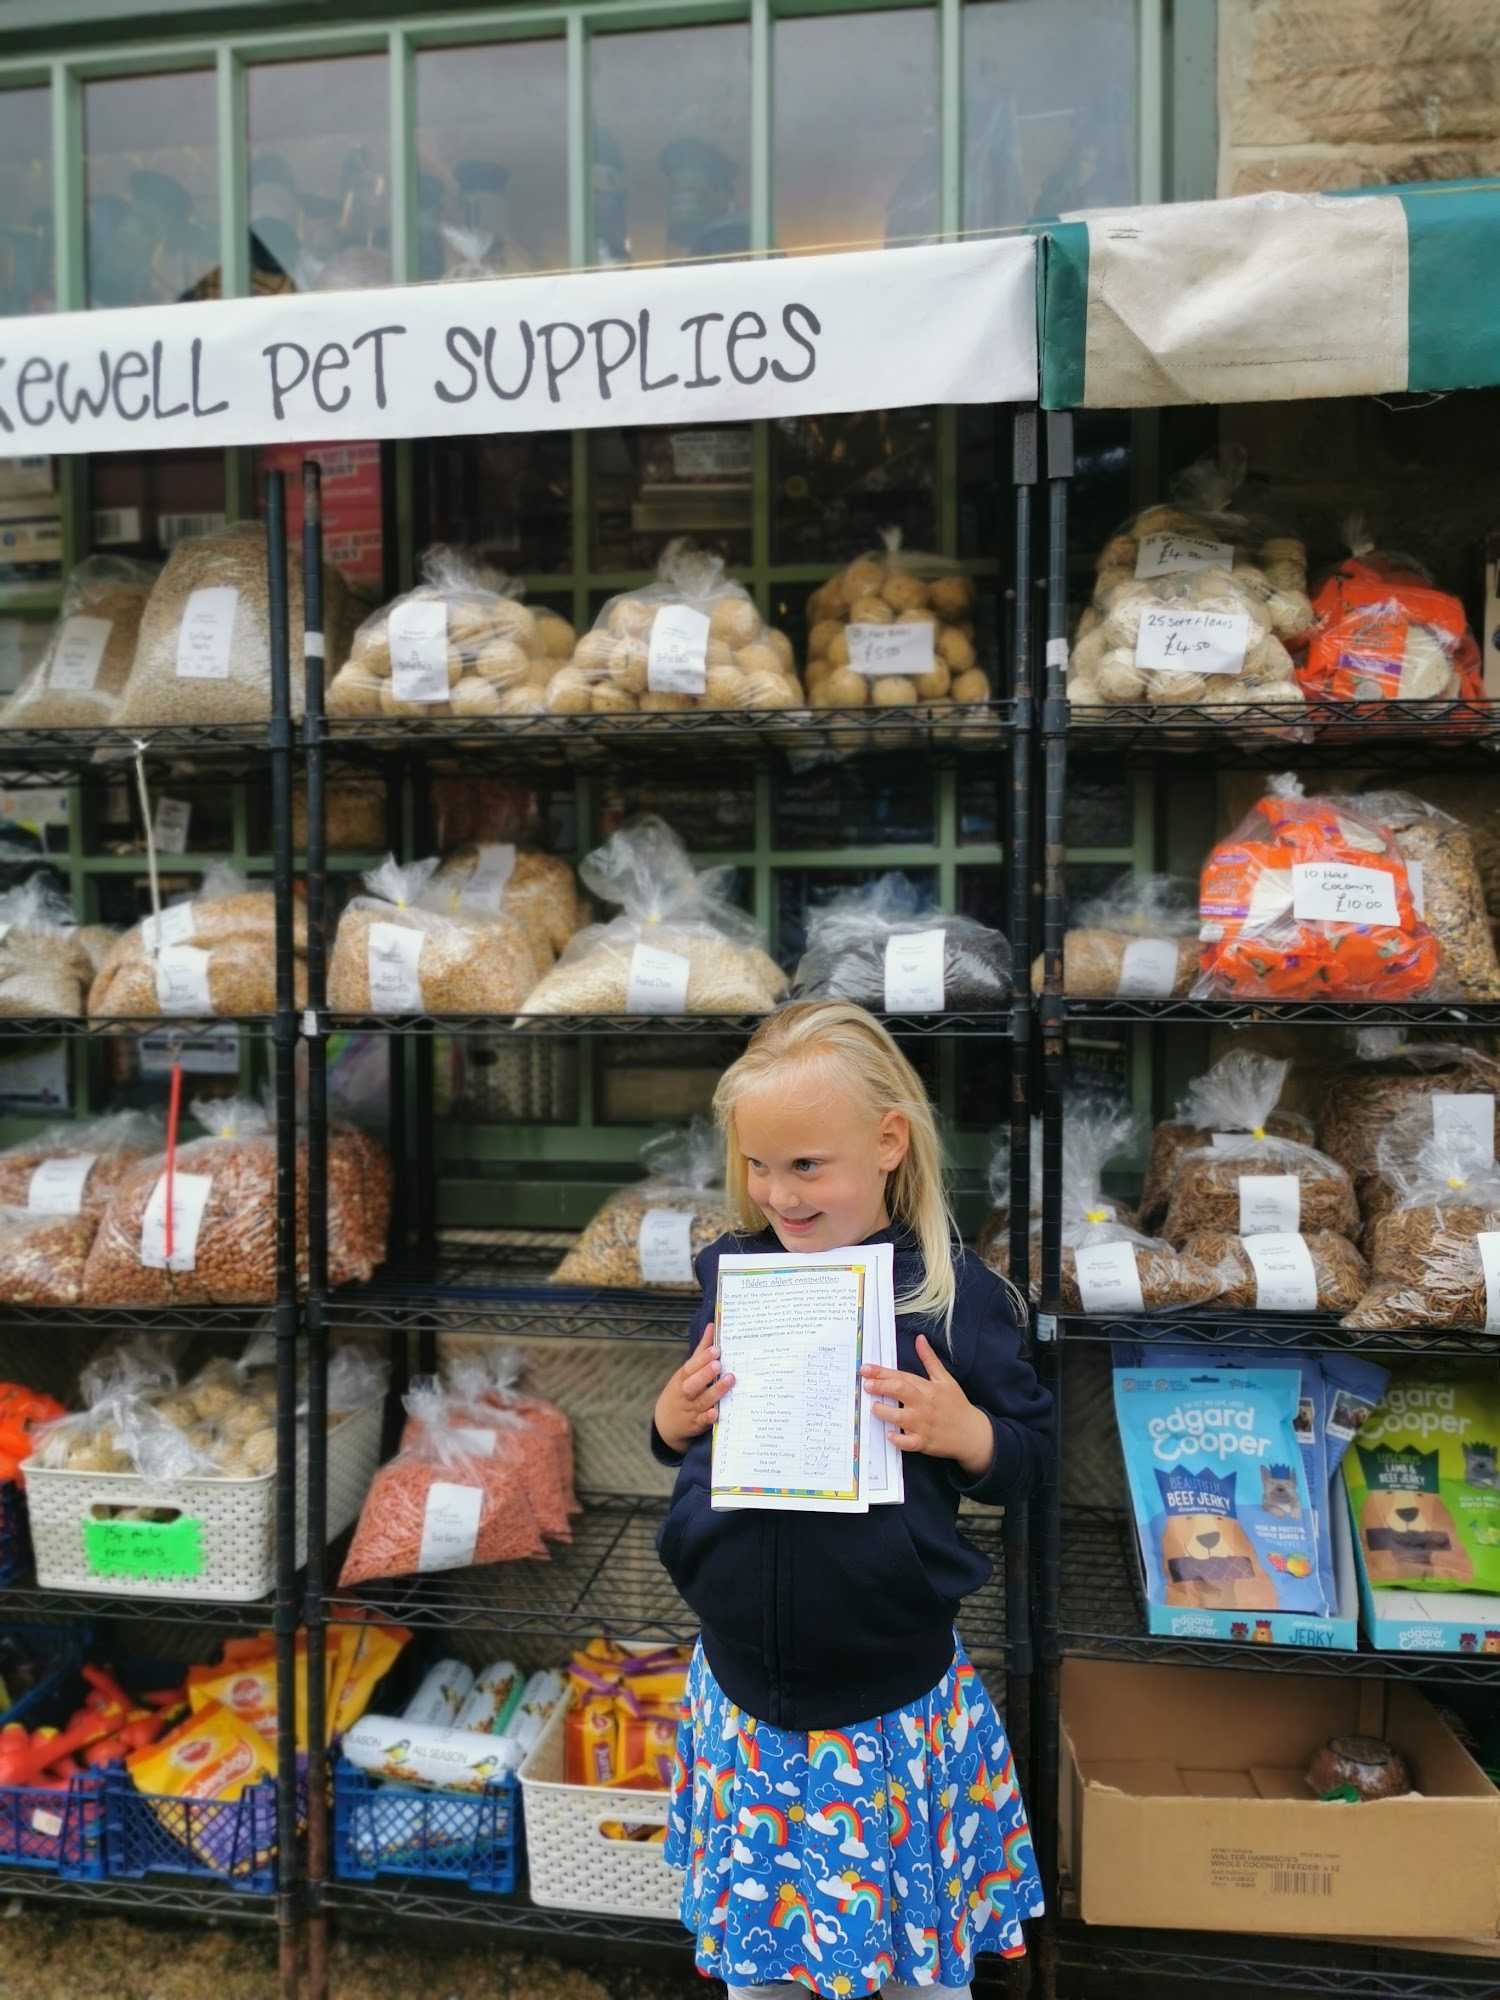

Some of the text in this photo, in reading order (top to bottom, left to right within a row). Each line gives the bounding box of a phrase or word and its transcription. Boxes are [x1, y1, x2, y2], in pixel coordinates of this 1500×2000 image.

[1148, 614, 1165, 626] 25
[1164, 632, 1211, 656] £4.50
[1304, 870, 1318, 880] 10
[1335, 893, 1383, 913] £10.00
[771, 1277, 792, 1286] object
[794, 1276, 840, 1285] competition
[1380, 1387, 1456, 1415] gard
[1148, 1407, 1255, 1439] edgard
[1153, 1431, 1271, 1461] Cooper
[1377, 1453, 1422, 1465] LUSCIOUS
[1385, 1464, 1417, 1474] LAMB &
[1170, 1476, 1222, 1496] BEAUTIFUL
[1379, 1473, 1426, 1486] BEEF JERKY
[1166, 1490, 1231, 1511] BEEF JERKY
[1256, 1531, 1278, 1539] GENTLY
[1172, 1616, 1215, 1629] edgard
[1172, 1624, 1218, 1638] Cooper
[1399, 1628, 1444, 1642] edgard
[1289, 1630, 1335, 1648] JERKY
[1399, 1636, 1448, 1649] Cooper
[412, 1745, 468, 1764] ALL SEASON
[1248, 1855, 1298, 1863] HARRISON'S
